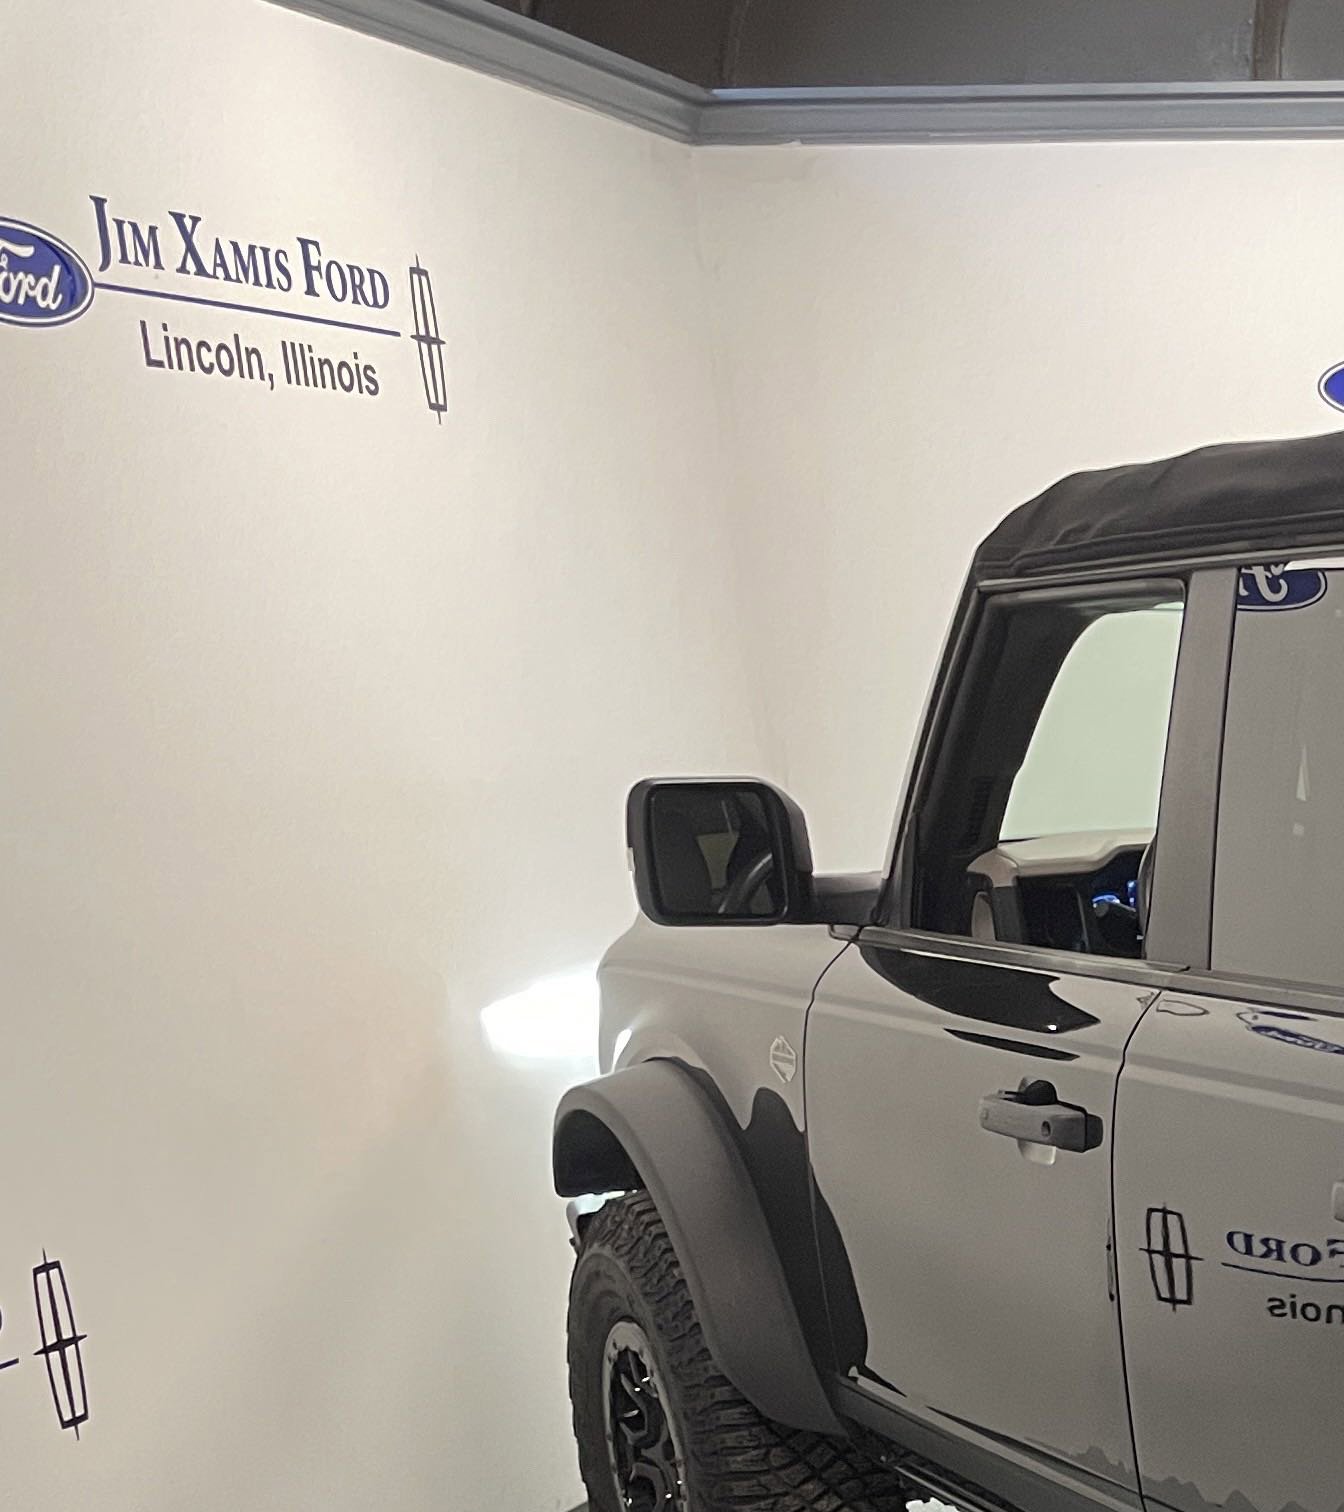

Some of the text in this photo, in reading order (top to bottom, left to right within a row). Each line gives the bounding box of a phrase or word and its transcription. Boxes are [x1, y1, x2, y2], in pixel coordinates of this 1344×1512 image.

[0, 242, 62, 311] ord
[89, 195, 390, 309] JIM XAMIS FORD
[140, 320, 380, 396] Lincoln, Illinois
